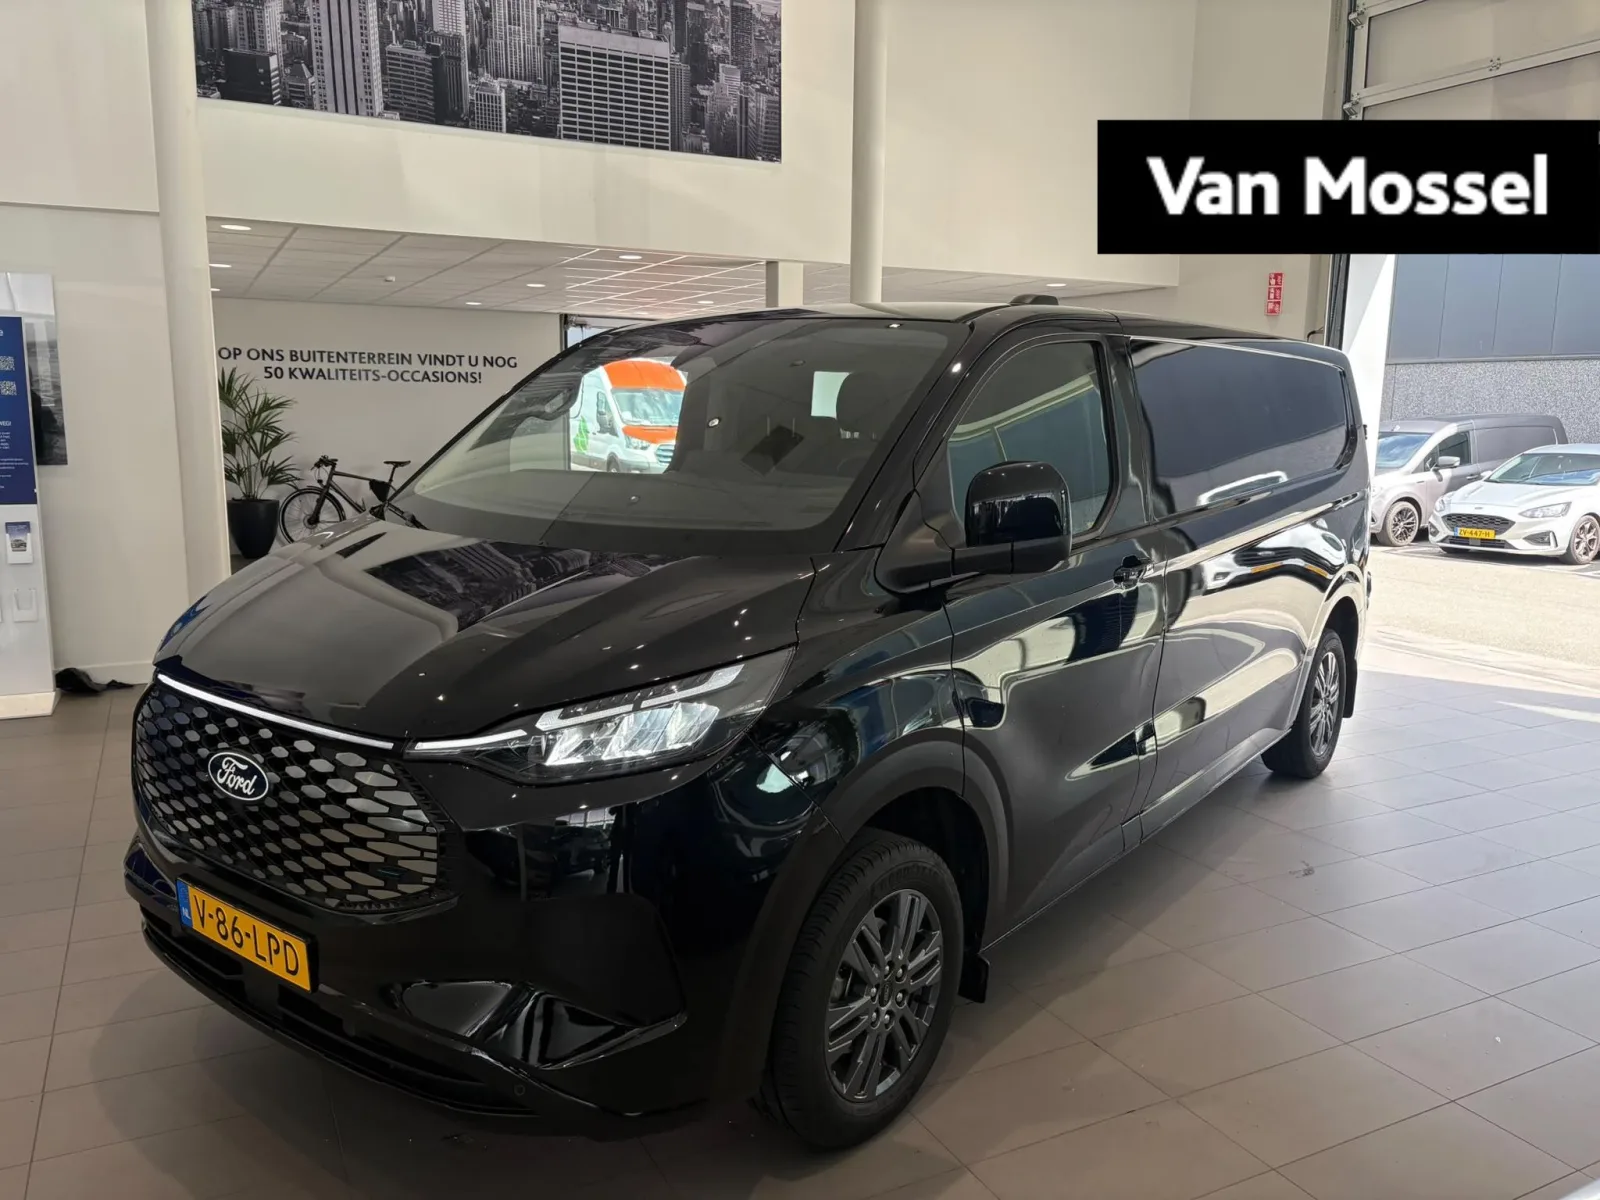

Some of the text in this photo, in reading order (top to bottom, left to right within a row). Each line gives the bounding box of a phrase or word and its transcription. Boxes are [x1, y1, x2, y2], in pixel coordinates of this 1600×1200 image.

[218, 347, 518, 368] OP ONS BUITENTERREIN VINDT U NOG
[263, 366, 482, 384] 50 KWALITEITS-OCCASIONS!
[217, 757, 258, 795] Ford
[193, 894, 300, 977] V-86-LPD
